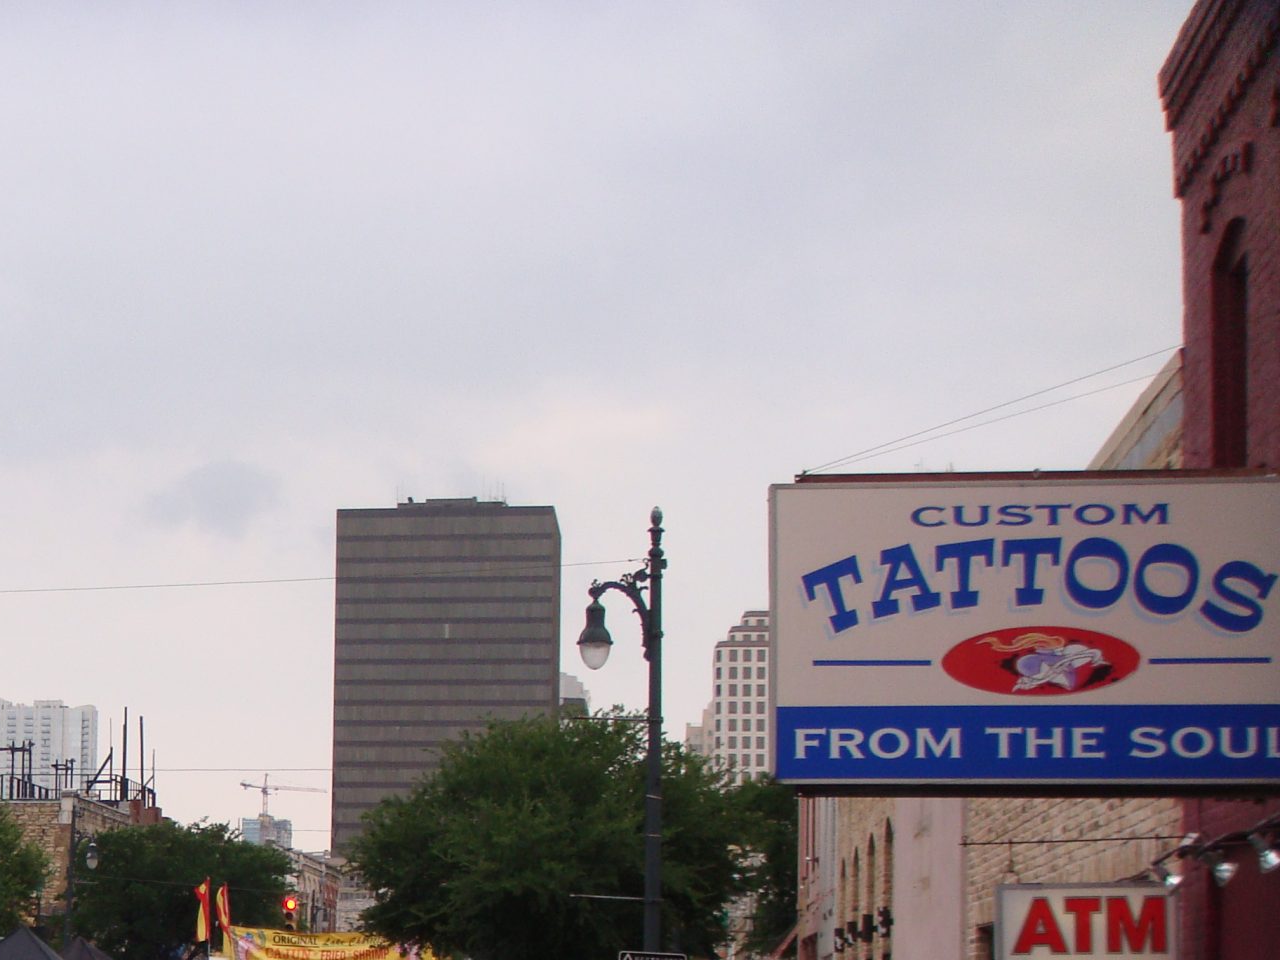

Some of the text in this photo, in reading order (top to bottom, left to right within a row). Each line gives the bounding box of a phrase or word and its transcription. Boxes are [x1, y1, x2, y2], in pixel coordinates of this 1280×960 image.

[911, 503, 1170, 527] CUSTOM
[800, 537, 1279, 635] TATTOOS
[794, 726, 1280, 760] FROM THE SOUL
[1012, 896, 1168, 954] ATM
[266, 948, 389, 960] CAJUN FRIED SHRIMP
[273, 935, 318, 945] ORIGINAL
